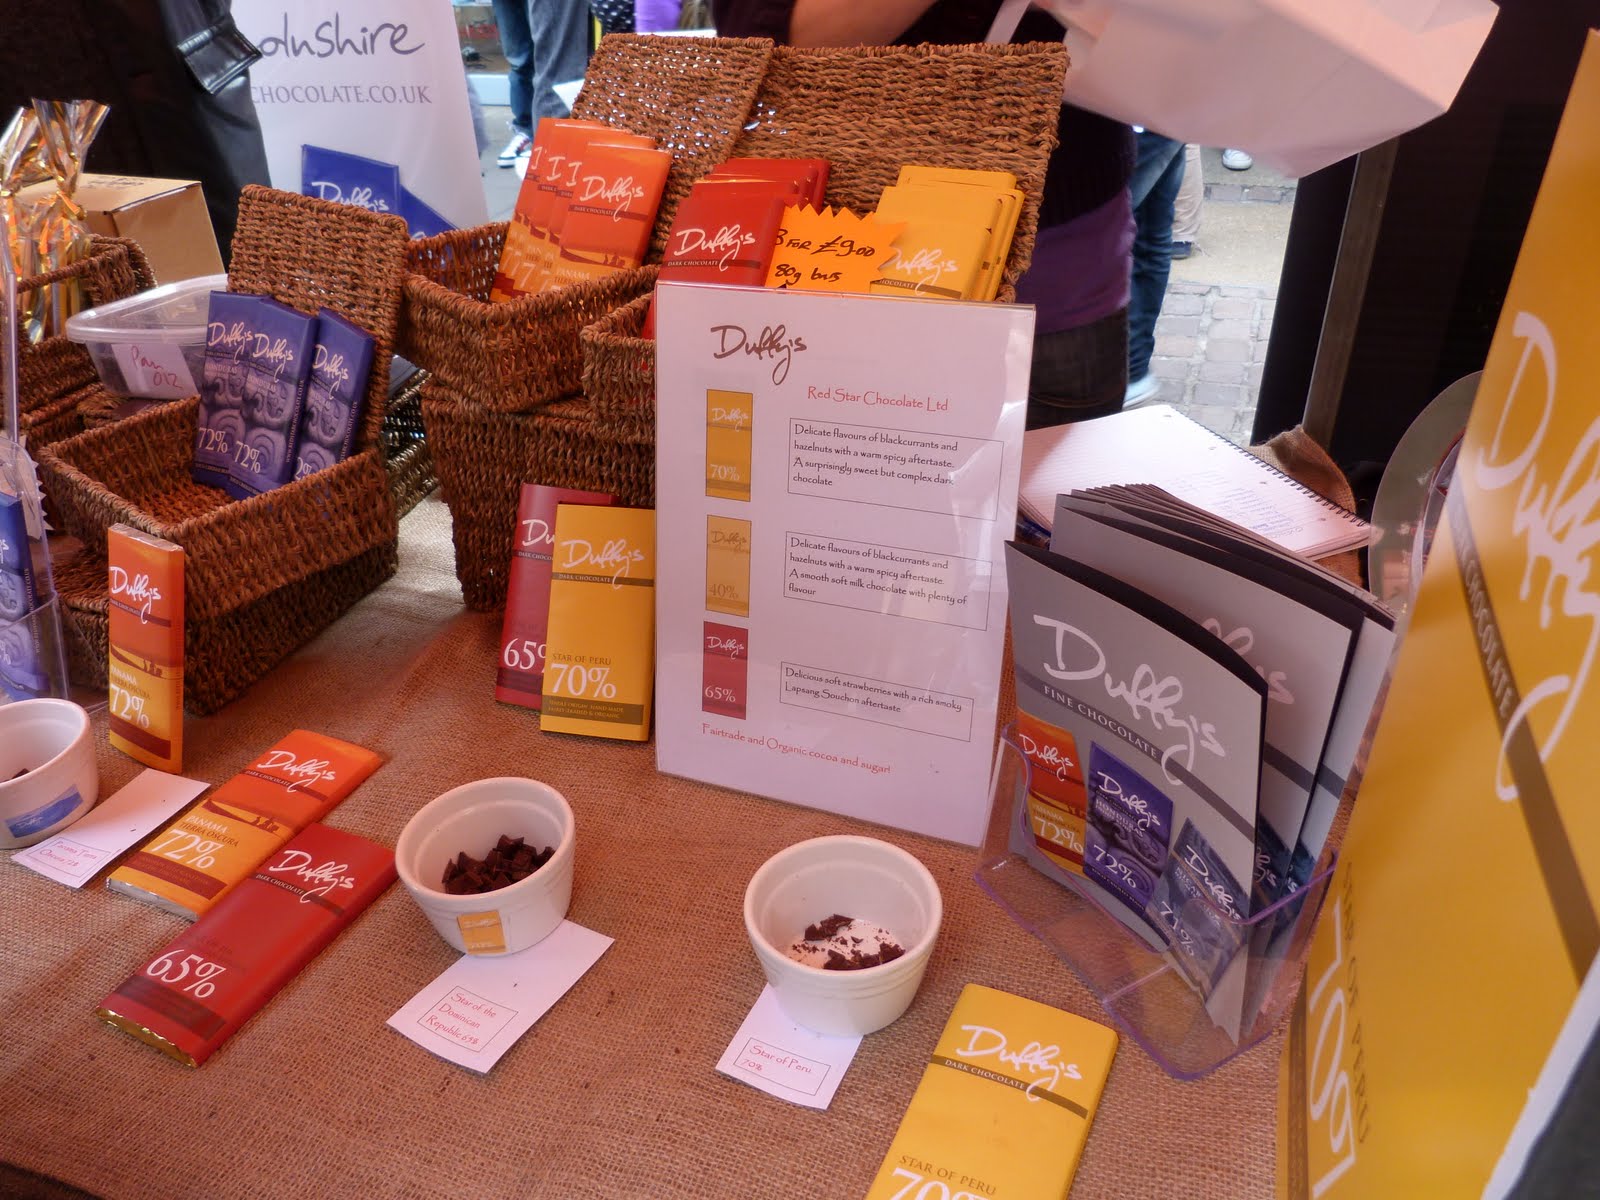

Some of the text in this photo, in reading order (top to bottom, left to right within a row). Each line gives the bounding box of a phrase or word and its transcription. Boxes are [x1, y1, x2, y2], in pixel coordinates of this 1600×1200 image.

[580, 176, 644, 222] Duffy's
[674, 224, 756, 272] Duffy's
[786, 239, 812, 250] FOR
[208, 321, 253, 364] Duffy's
[252, 333, 294, 383] Duffy's
[710, 324, 807, 385] Duffy's
[312, 343, 349, 400] Duffy's
[807, 386, 948, 412] Red Star Chocolate Ltd
[198, 426, 228, 454] 72%
[794, 423, 958, 451] Delicate flavours of blackcurrants and
[794, 440, 833, 454] hazelnuts
[834, 446, 851, 456] with
[860, 451, 882, 459] warm
[883, 454, 906, 465] spicy
[234, 441, 261, 474] 72%
[710, 463, 741, 481] 70%
[793, 456, 803, 468] A
[805, 460, 852, 475] surprisingly
[854, 466, 879, 476] sweet
[880, 466, 895, 478] but
[897, 472, 933, 484] complex
[793, 472, 833, 486] chocolate
[532, 552, 553, 560] CHOCO
[561, 538, 645, 589] Duffy's
[789, 552, 827, 567] hazelnuts
[829, 559, 846, 570] with
[853, 565, 875, 574] warm
[876, 567, 899, 580] spicy
[790, 537, 949, 569] Delicate flavours of blackcurrants and
[109, 566, 162, 624] Duffy's
[575, 575, 611, 583] CHOCOLATE
[788, 582, 817, 596] flavour
[789, 568, 968, 606] A smooth soft milk chocolate with plenty of
[552, 653, 612, 666] STAR OF PERU
[706, 636, 745, 660] Duffy's
[550, 662, 617, 699] 70%
[704, 685, 736, 703] 65%
[785, 667, 824, 683] Delicious
[824, 676, 841, 686] soft
[842, 681, 891, 697] strawberries
[892, 690, 910, 700] with
[918, 695, 934, 705] rich
[935, 700, 962, 712] smoky
[110, 683, 150, 729] 72%
[785, 681, 902, 713] Lapsang Souchon aftertaste
[1033, 614, 1226, 786] Duffy's
[1043, 685, 1158, 759] FINE CHOCOLATE
[702, 723, 891, 774] Fairtrade and Organic cocoa and sugar!
[1019, 733, 1074, 781] Duffy's
[256, 750, 336, 793] Duffy's
[260, 773, 290, 787] CHOCOLATE
[1097, 771, 1160, 831] Duffy's
[180, 822, 240, 847] TIERRA OSCURA
[185, 815, 229, 834] PANAMA
[1034, 815, 1084, 854] 72%
[151, 829, 226, 869] 72%
[268, 850, 355, 904] Duffy's
[1093, 844, 1137, 889] 72%
[1184, 844, 1242, 920] Duffy's
[255, 873, 304, 895] DARK CHOCOLATE
[146, 949, 227, 998] 65%
[438, 1002, 481, 1029] Dominican
[450, 992, 496, 1018] Star of the
[426, 1014, 461, 1038] Republic
[741, 1058, 763, 1072] 70%
[749, 1045, 812, 1073] Star of Peru
[944, 1059, 1025, 1090] DARK CHOCOLATE
[956, 1024, 1083, 1102] Duffy's
[899, 1155, 997, 1196] STAR OF PERU
